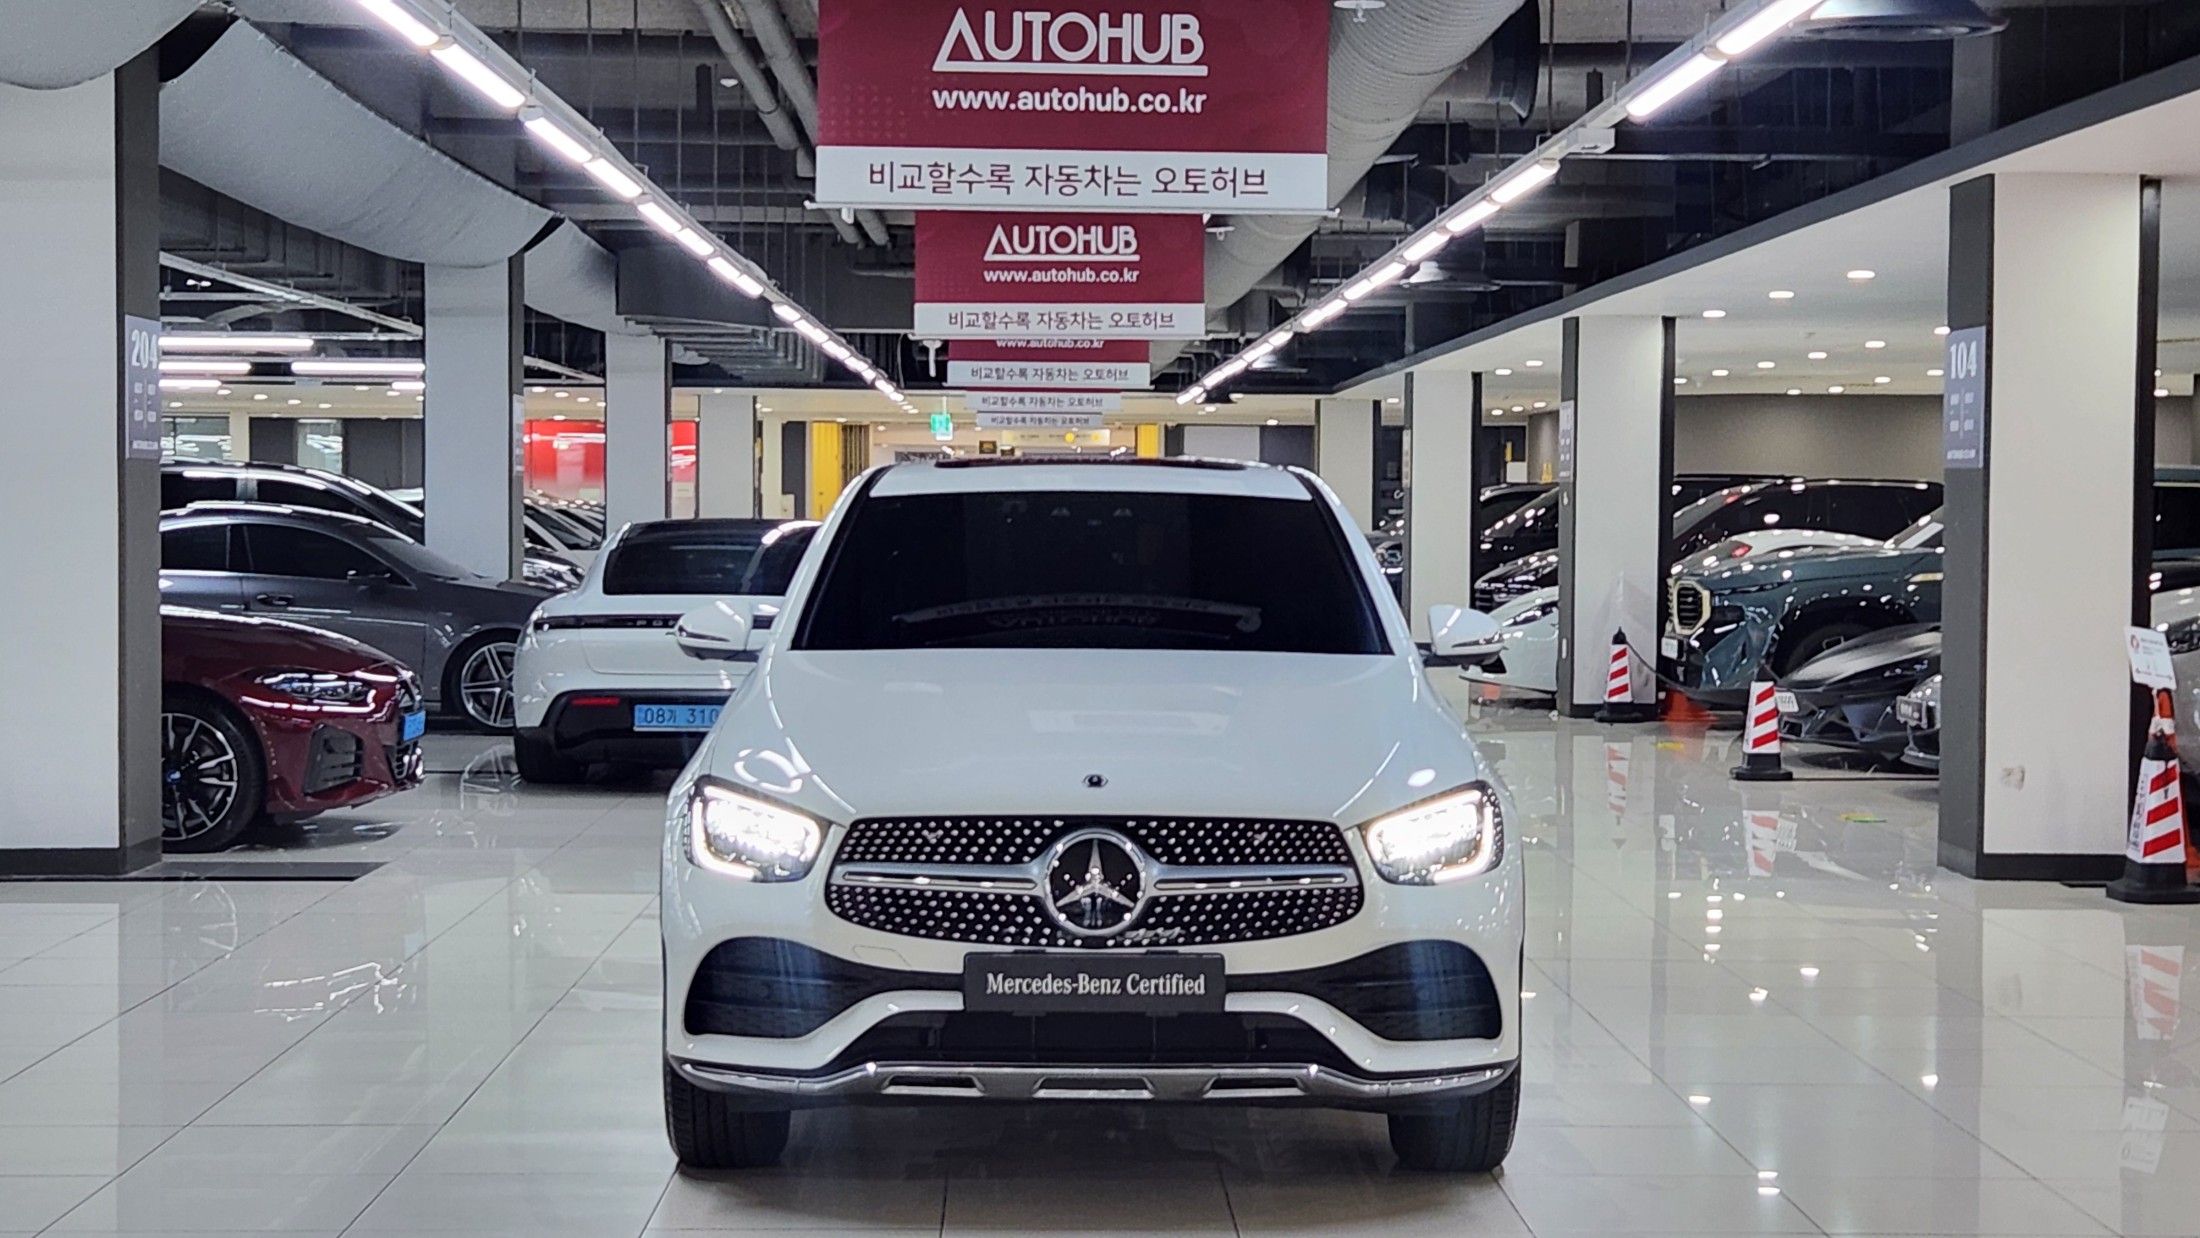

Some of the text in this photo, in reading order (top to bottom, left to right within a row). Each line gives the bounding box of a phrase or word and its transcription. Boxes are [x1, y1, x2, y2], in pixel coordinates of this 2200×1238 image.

[932, 6, 1208, 76] AUTOHUB
[932, 87, 1207, 113] www.autohub.co.kr
[869, 161, 1269, 198] 비교할수록 자동차는 오토허브
[983, 223, 1141, 262] AUTOHUB
[983, 267, 1140, 284] www.autohub.co.kr
[948, 311, 1175, 330] 비교할수록 자동차는 오토허브
[131, 328, 158, 370] 204
[1949, 340, 1977, 380] 104
[971, 366, 1129, 381] 비교할수록 자동차는 오토허브
[687, 708, 720, 724] 310
[986, 972, 1206, 995] Mercedes-Benz Certified
